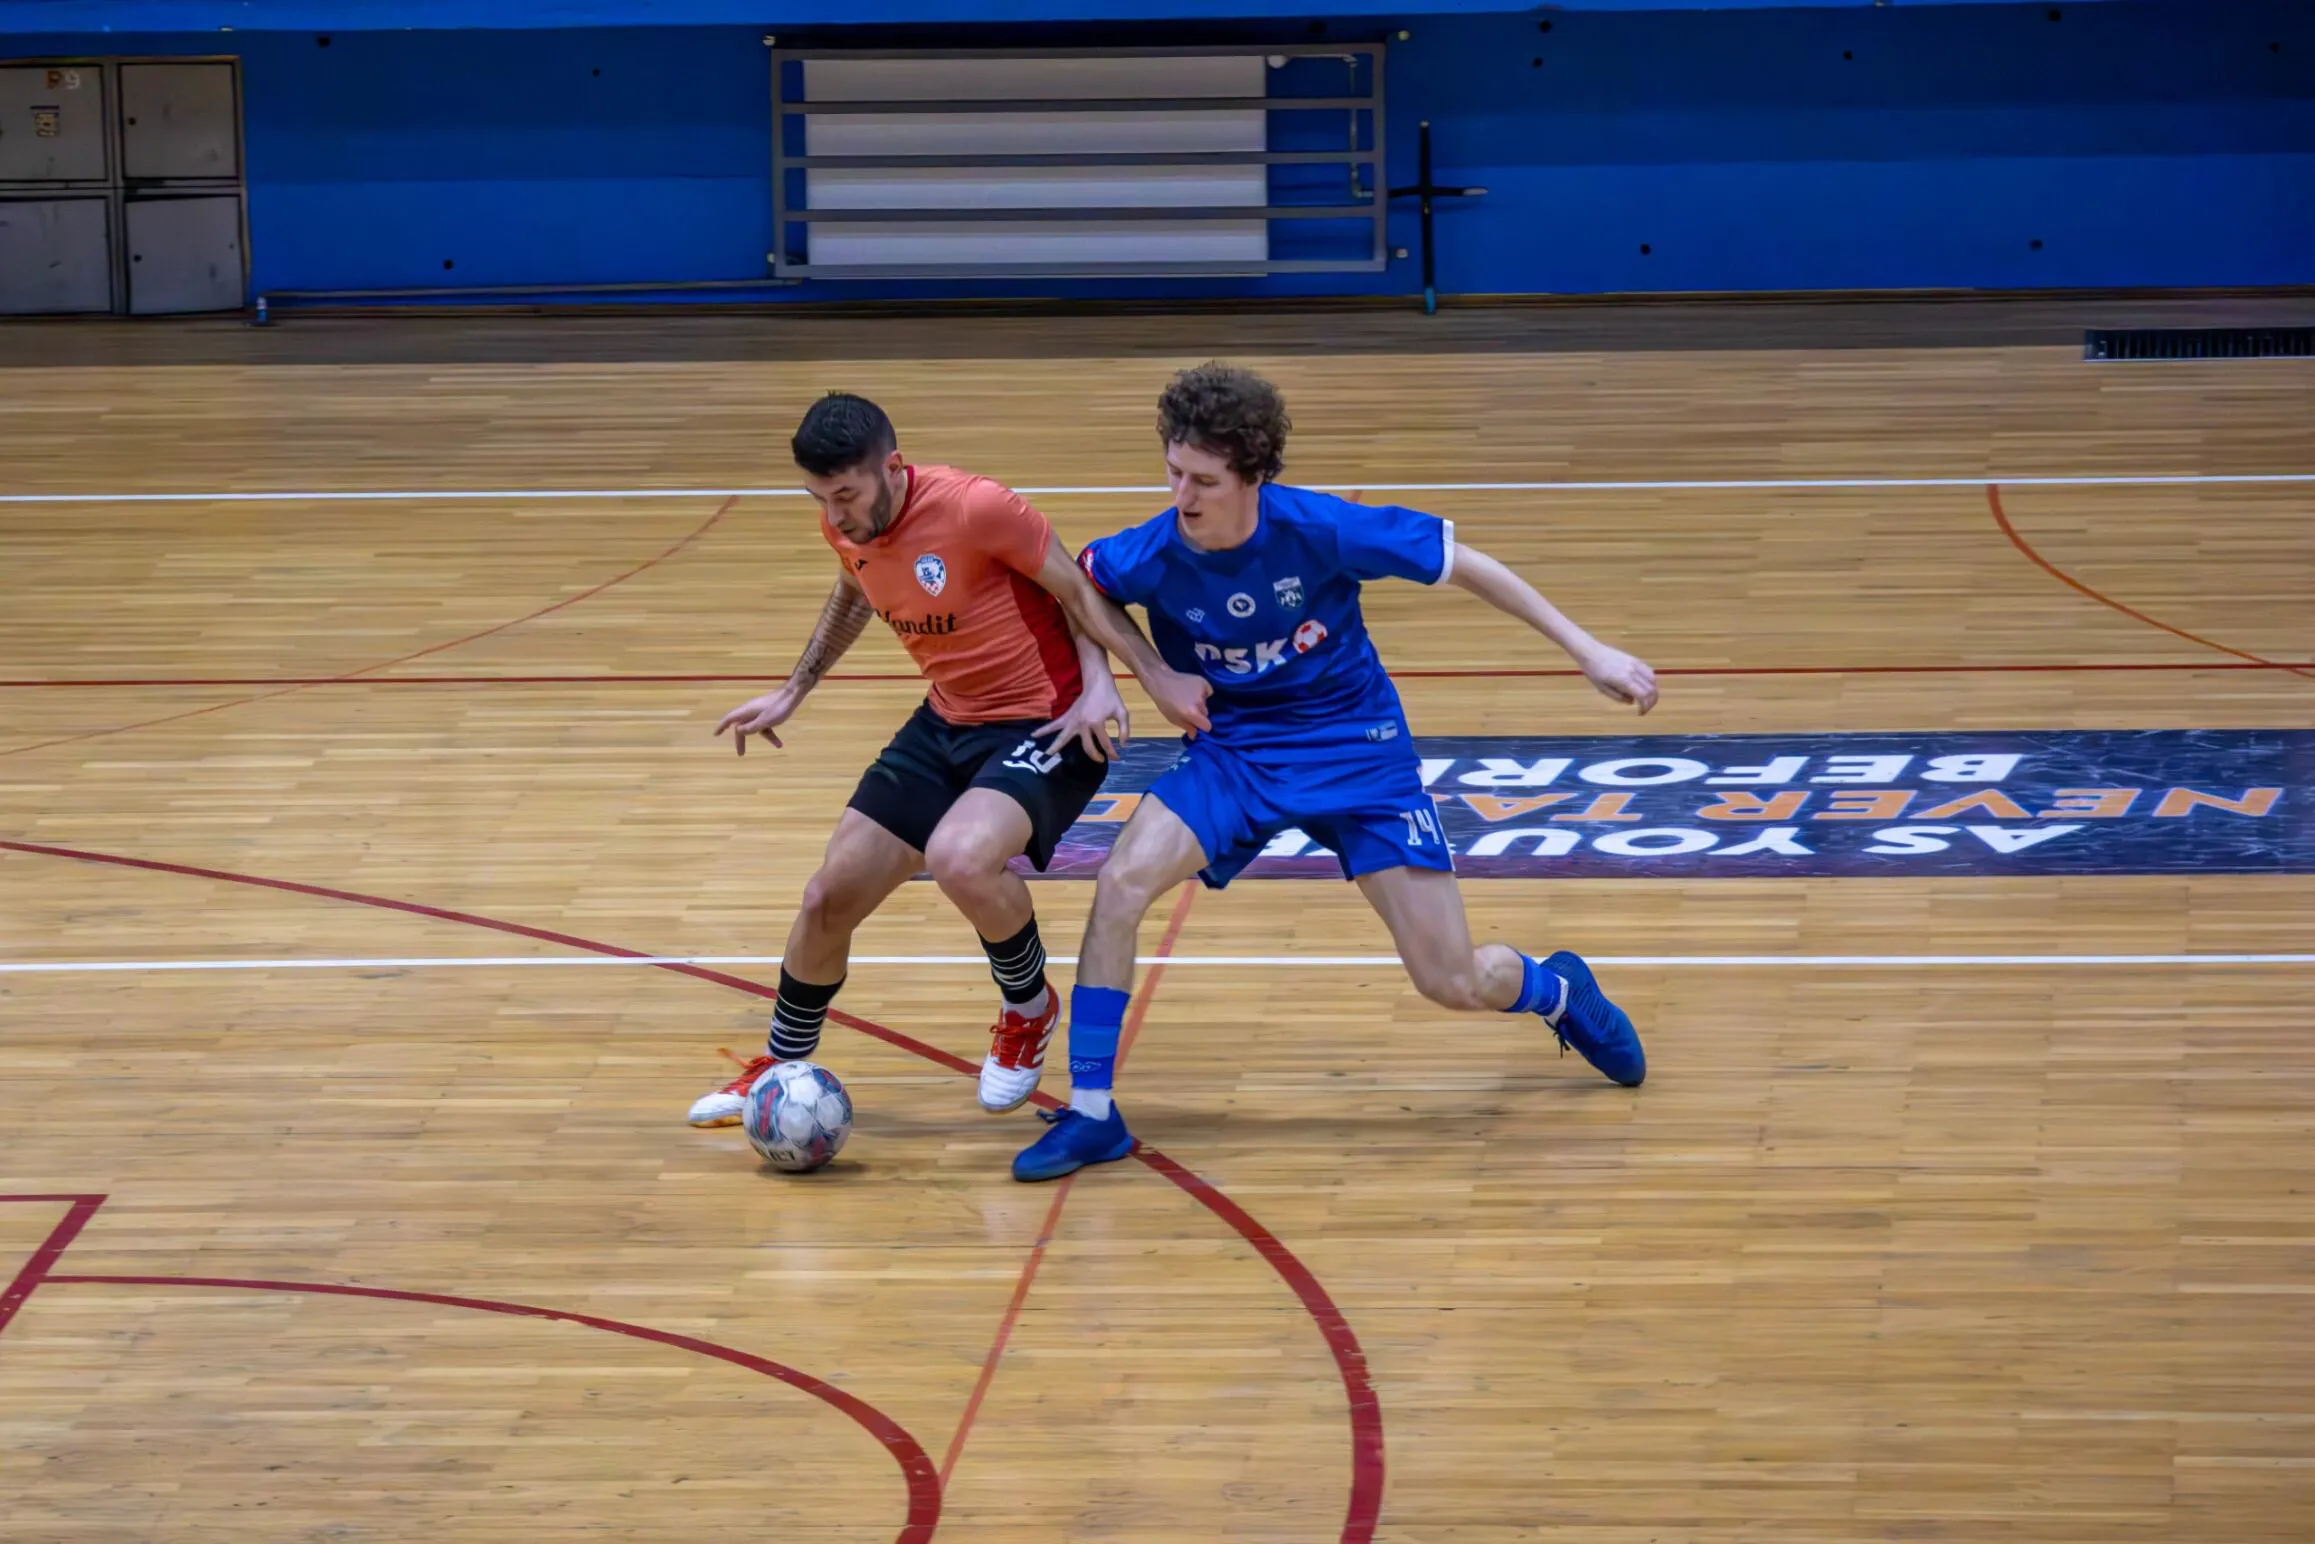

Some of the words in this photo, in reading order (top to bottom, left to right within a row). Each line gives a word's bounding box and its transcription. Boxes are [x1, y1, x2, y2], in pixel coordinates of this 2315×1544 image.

[1694, 787, 2284, 822] NEVER
[1399, 808, 1440, 846] 14
[1861, 823, 2087, 855] AS
